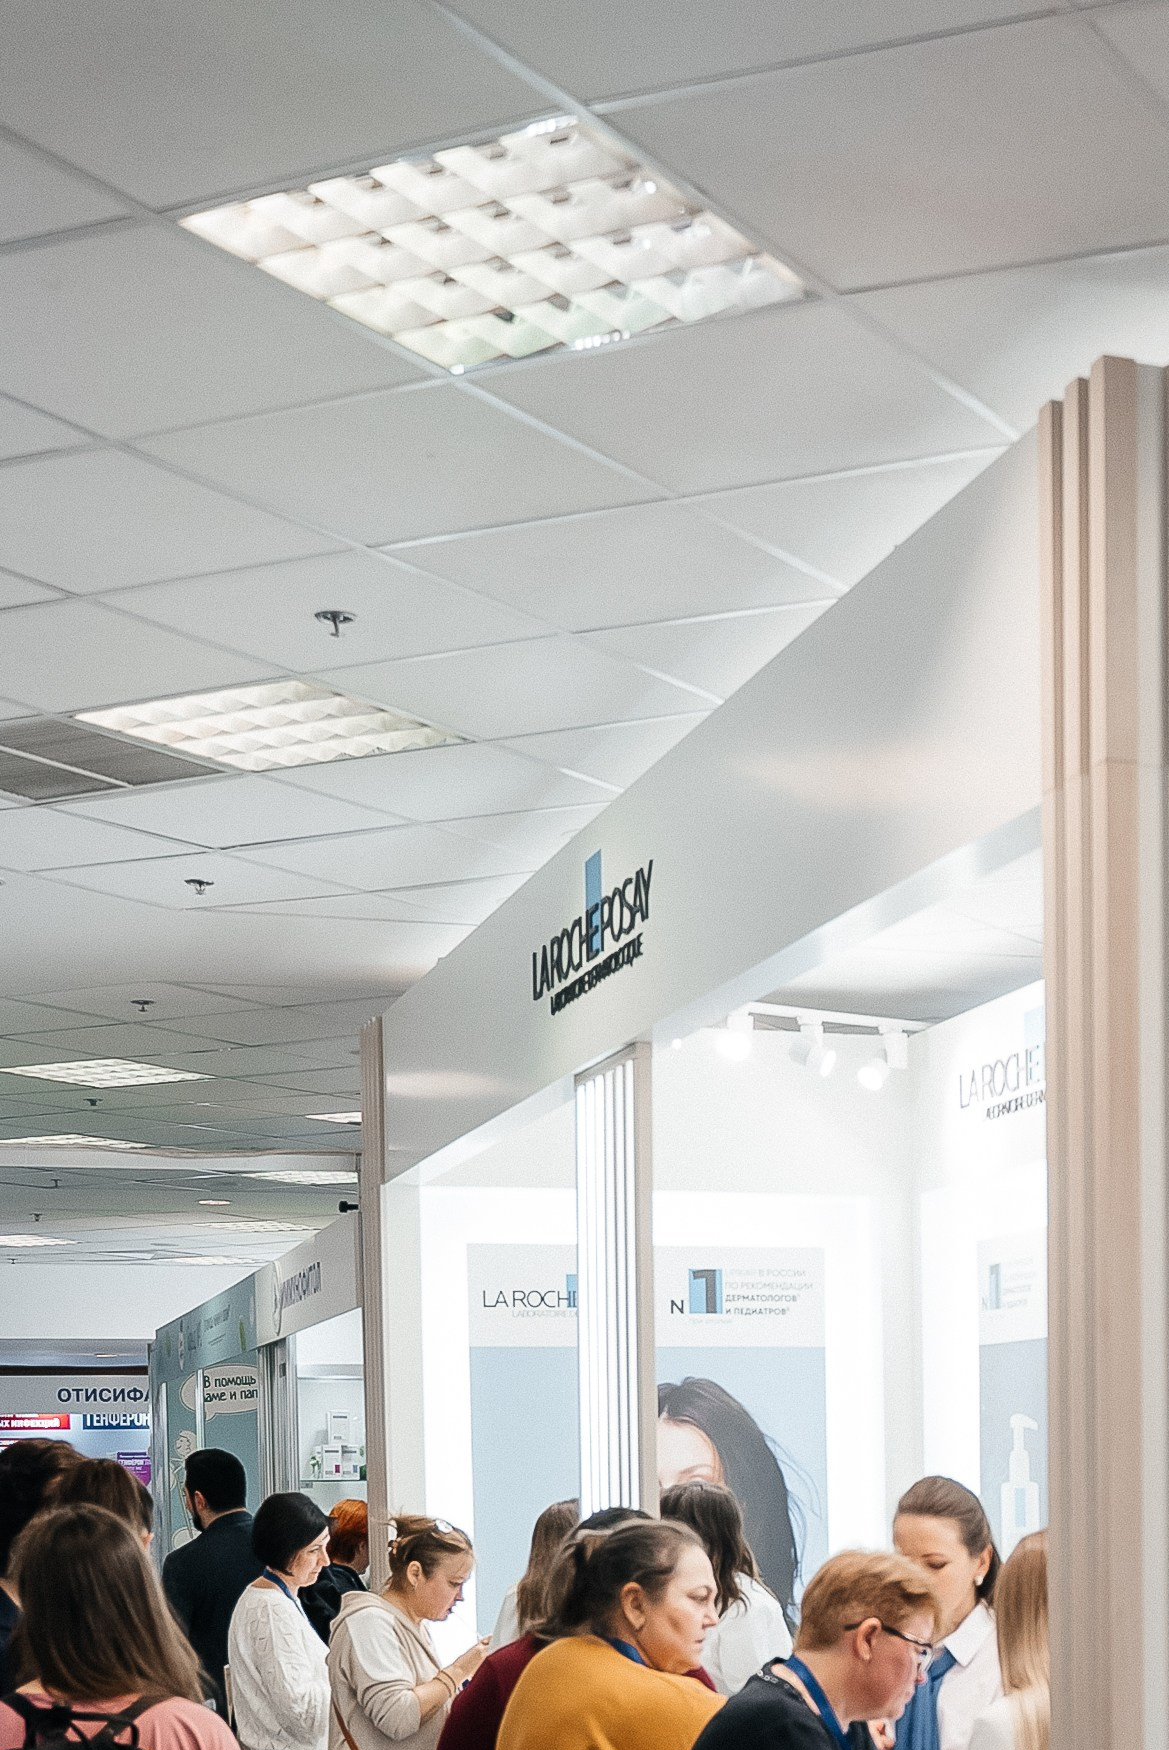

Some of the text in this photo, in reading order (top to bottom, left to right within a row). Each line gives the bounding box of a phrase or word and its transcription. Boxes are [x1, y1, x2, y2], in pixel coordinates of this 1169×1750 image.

[532, 944, 550, 1001] LA
[550, 902, 599, 989] ROCHE
[600, 859, 654, 952] POSAY
[482, 1289, 509, 1308] LA
[670, 1268, 718, 1315] N 1
[203, 1375, 257, 1389] В помощь
[203, 1389, 258, 1403] аме и пап
